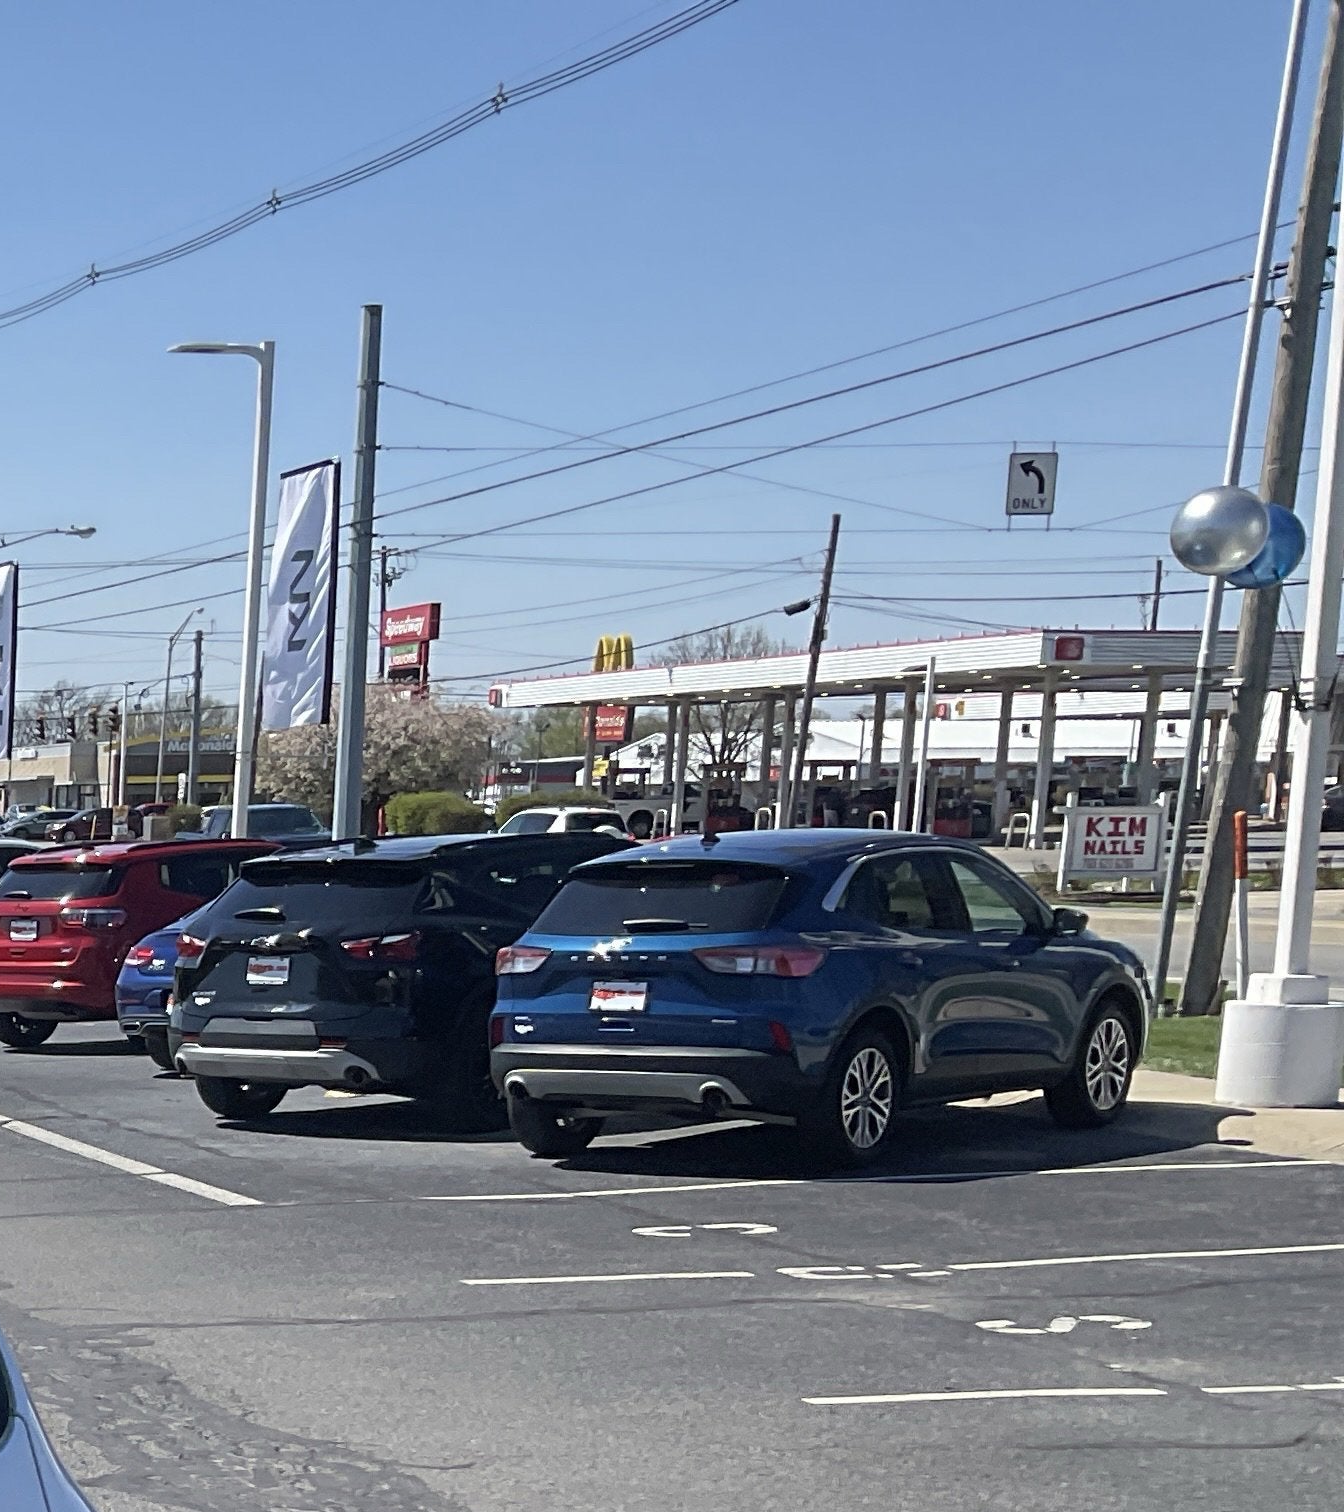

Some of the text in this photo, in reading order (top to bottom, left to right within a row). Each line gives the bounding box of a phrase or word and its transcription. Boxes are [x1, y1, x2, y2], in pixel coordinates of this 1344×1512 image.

[1012, 498, 1047, 509] ONLY
[384, 615, 426, 640] Speedway
[1085, 816, 1148, 837] KIM
[1083, 840, 1146, 855] NAILS
